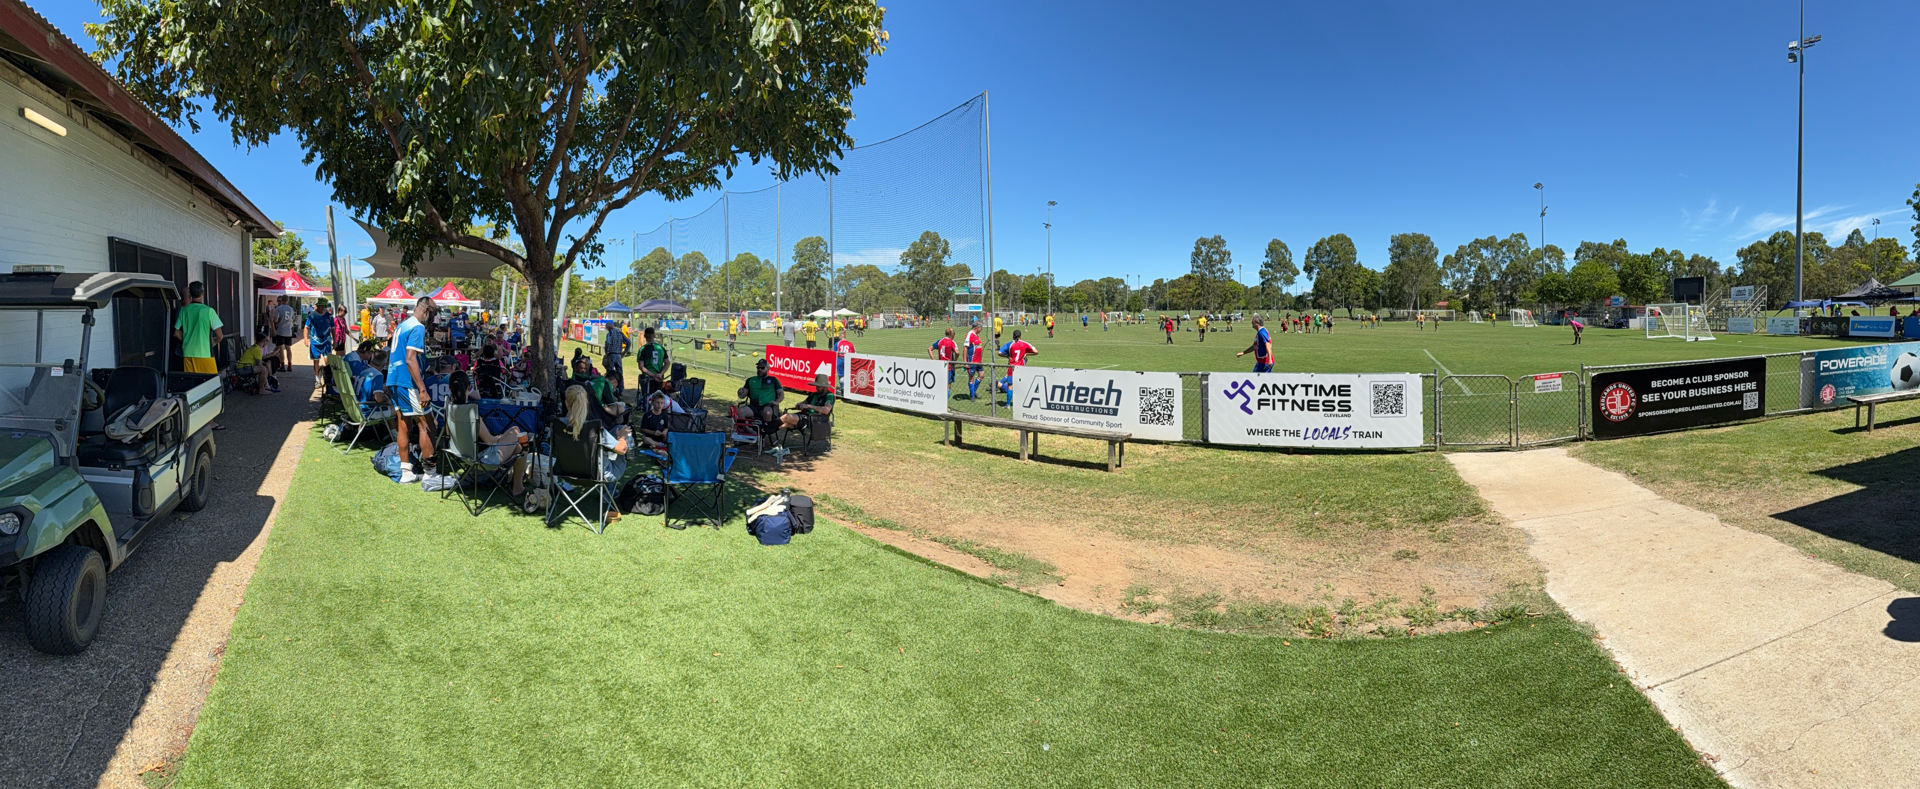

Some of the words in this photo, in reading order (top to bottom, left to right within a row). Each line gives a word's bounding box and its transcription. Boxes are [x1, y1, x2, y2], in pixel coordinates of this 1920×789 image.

[456, 320, 464, 328] 13
[840, 345, 849, 353] 16
[1014, 350, 1020, 362] 7
[652, 351, 658, 364] 5
[769, 354, 810, 373] SIMONDS
[1820, 355, 1887, 371] POWERADE
[878, 362, 936, 389] xburo
[1651, 377, 1684, 388] BECOME
[1692, 375, 1712, 383] CLUB
[1714, 371, 1749, 381] SPONSOR
[429, 383, 451, 402] 19
[913, 391, 935, 400] delivery
[1022, 375, 1122, 408] Antech
[1258, 383, 1351, 397] ANYTIME
[1642, 393, 1660, 402] SEE
[1662, 390, 1687, 400] YOUR
[1688, 385, 1733, 397] BUSINESS
[1734, 382, 1757, 392] HERE
[1050, 404, 1114, 414] CONSTRUCTIONS
[1257, 399, 1352, 412] FITNESS
[1638, 400, 1741, 417] SPONSORSHIP@REDLANDSUNITED.COM.AU
[1040, 415, 1062, 423] Sponsor
[1070, 418, 1104, 428] Community
[1246, 428, 1280, 437] WHERE
[1303, 425, 1352, 440] LOCALS
